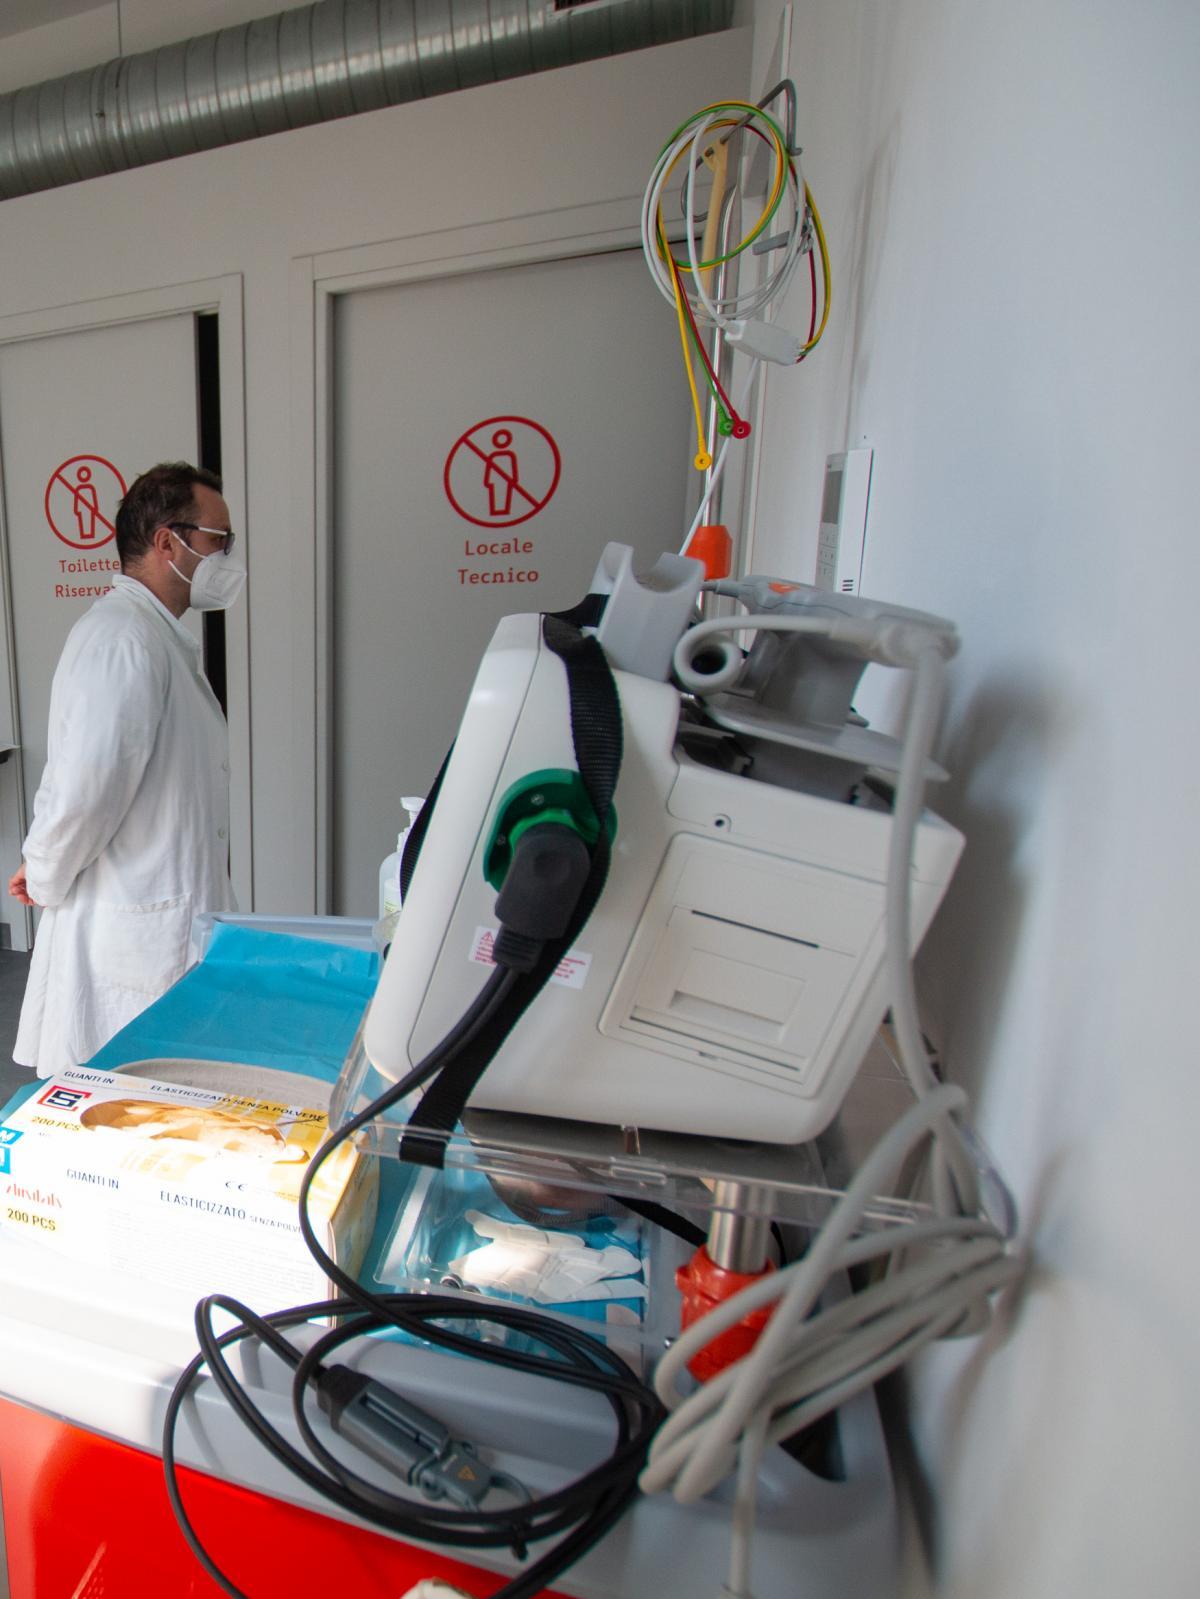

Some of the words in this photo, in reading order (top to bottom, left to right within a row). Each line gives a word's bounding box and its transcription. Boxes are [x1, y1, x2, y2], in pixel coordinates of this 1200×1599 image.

[465, 538, 533, 556] Locale
[59, 559, 120, 573] Toilette
[458, 567, 539, 585] Tecnico
[55, 584, 116, 598] Riserva
[7, 1207, 29, 1224] 200
[32, 1215, 57, 1232] PCS
